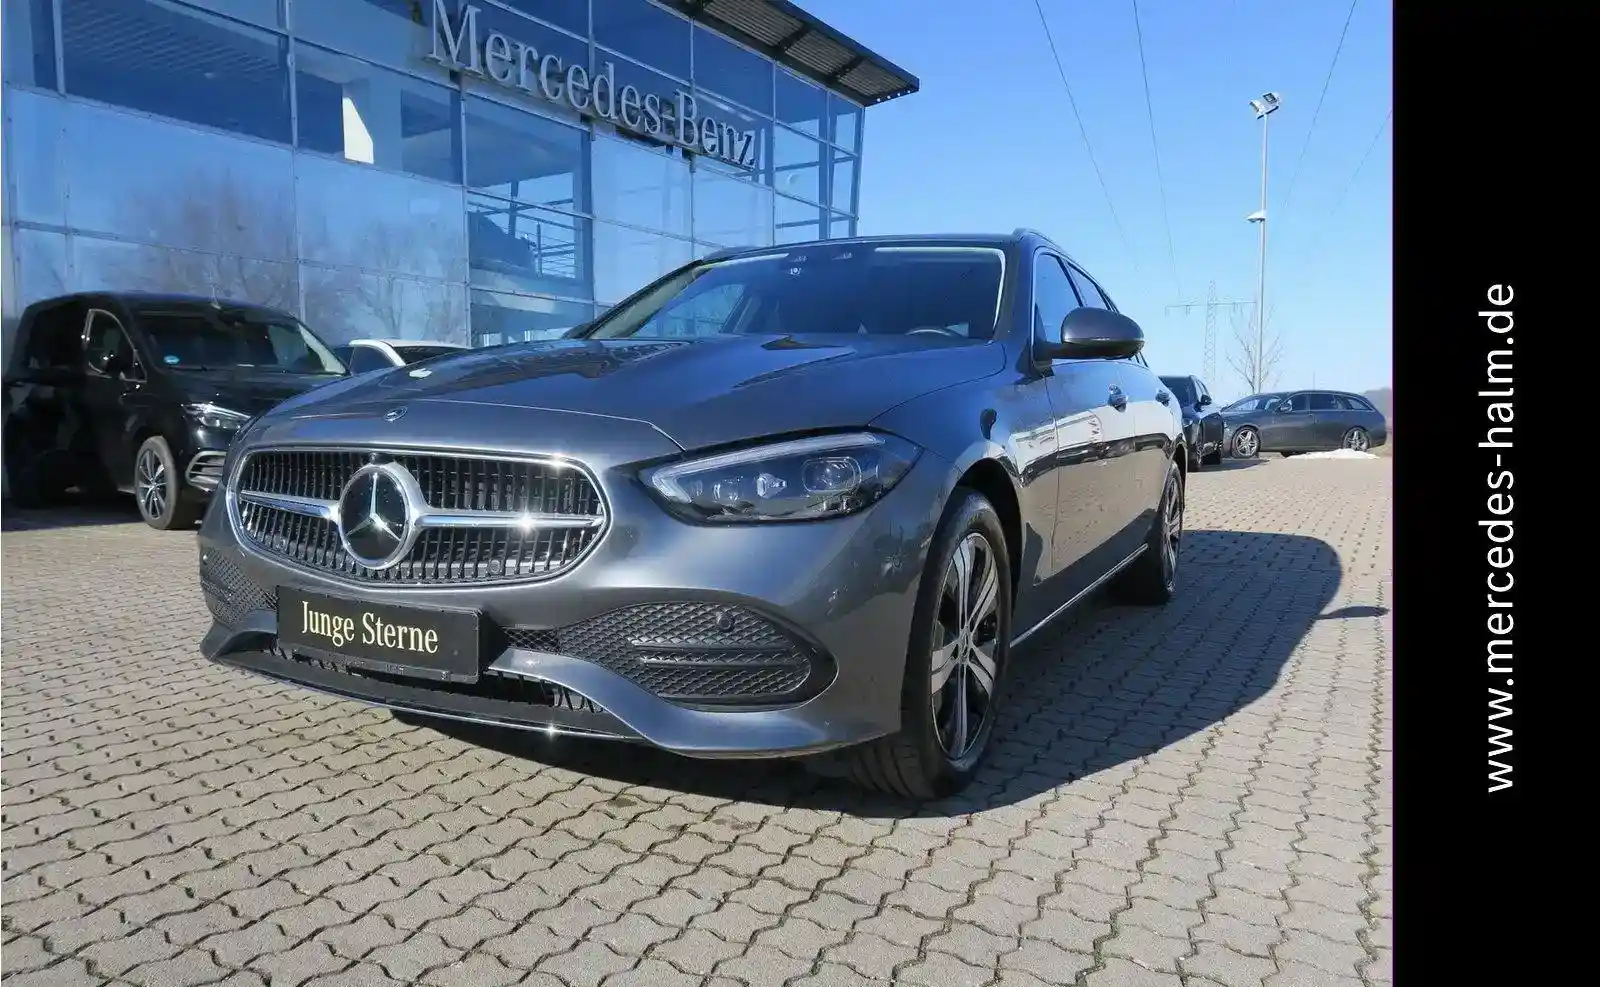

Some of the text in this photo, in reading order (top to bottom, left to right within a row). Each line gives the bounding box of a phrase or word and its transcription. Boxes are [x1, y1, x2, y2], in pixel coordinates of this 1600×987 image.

[428, 0, 756, 171] Mercedes-Benz
[301, 600, 439, 654] Junge Sterne
